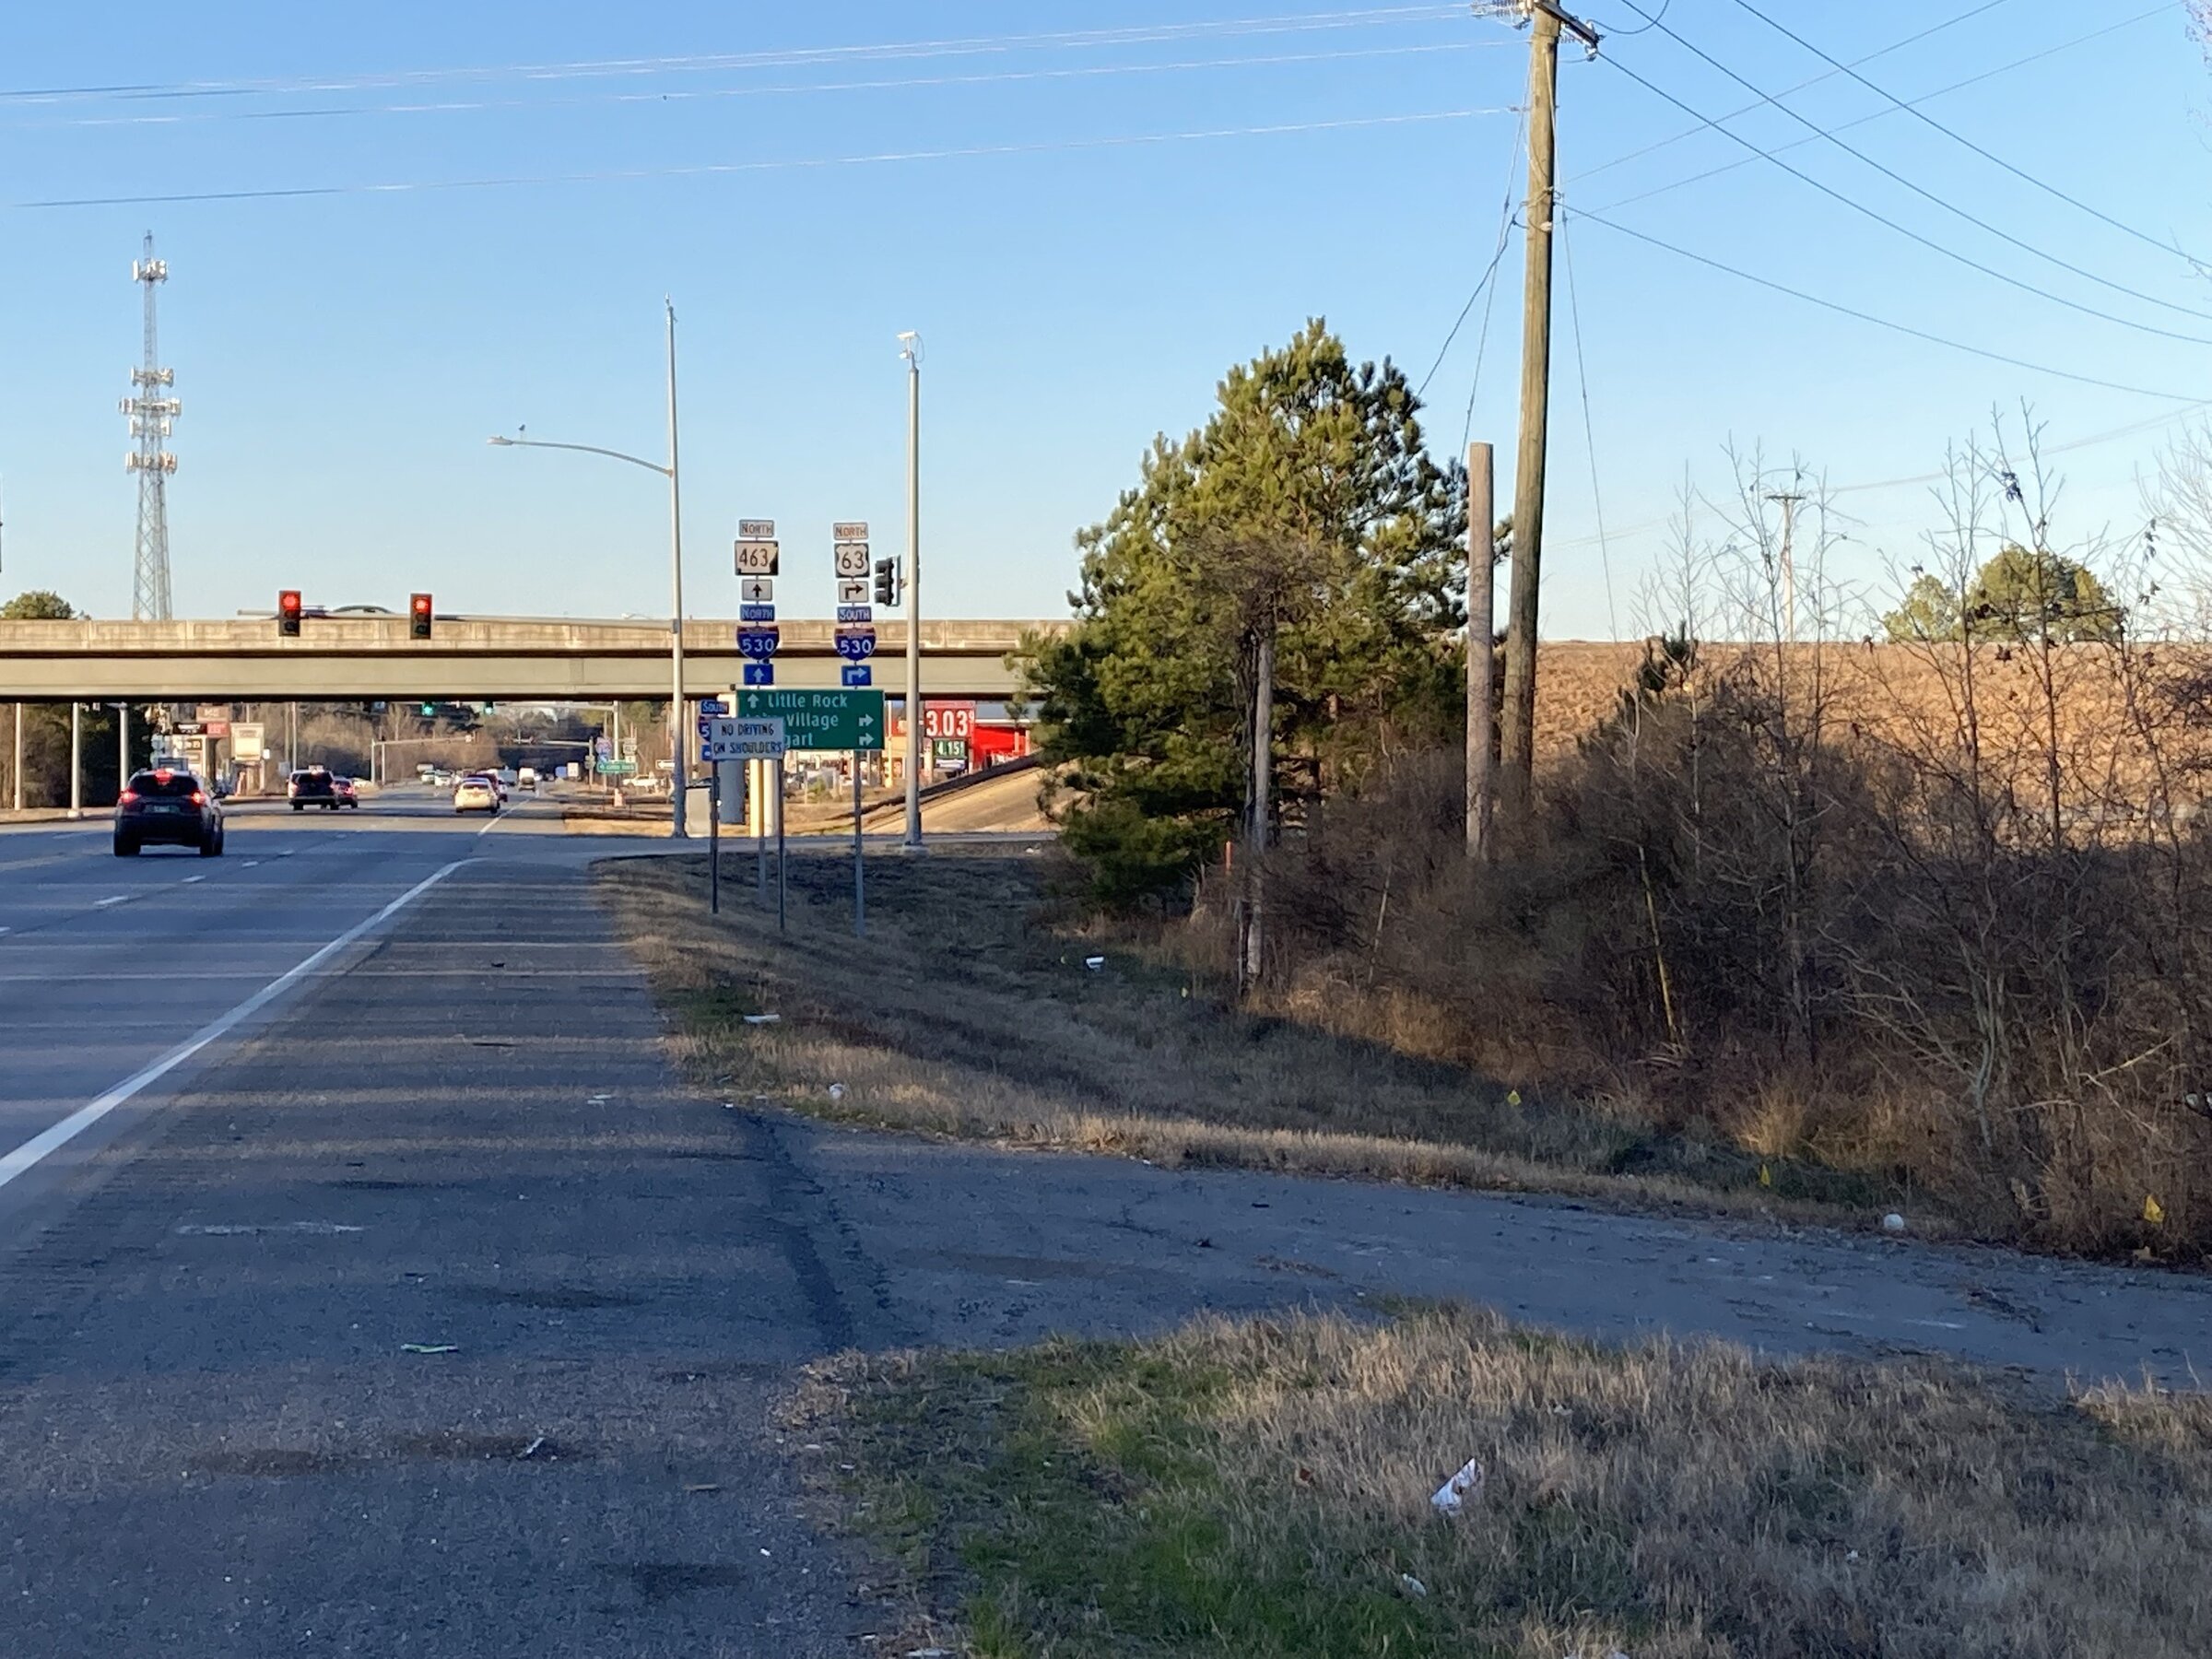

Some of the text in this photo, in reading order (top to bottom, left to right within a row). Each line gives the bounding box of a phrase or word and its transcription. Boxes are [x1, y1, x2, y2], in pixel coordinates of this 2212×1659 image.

[741, 524, 773, 535] NORTH
[835, 527, 866, 537] NORTH
[738, 547, 769, 567] 463
[841, 550, 865, 570] 63
[741, 607, 774, 619] NORTH
[839, 608, 870, 620] SOUTH
[742, 638, 775, 653] 530
[840, 639, 872, 653] 530
[768, 693, 848, 708] Little Rock
[786, 712, 839, 730] Village
[721, 724, 734, 735] NO
[738, 723, 774, 735] DRIVING
[713, 742, 782, 754] ON SHOULDERS
